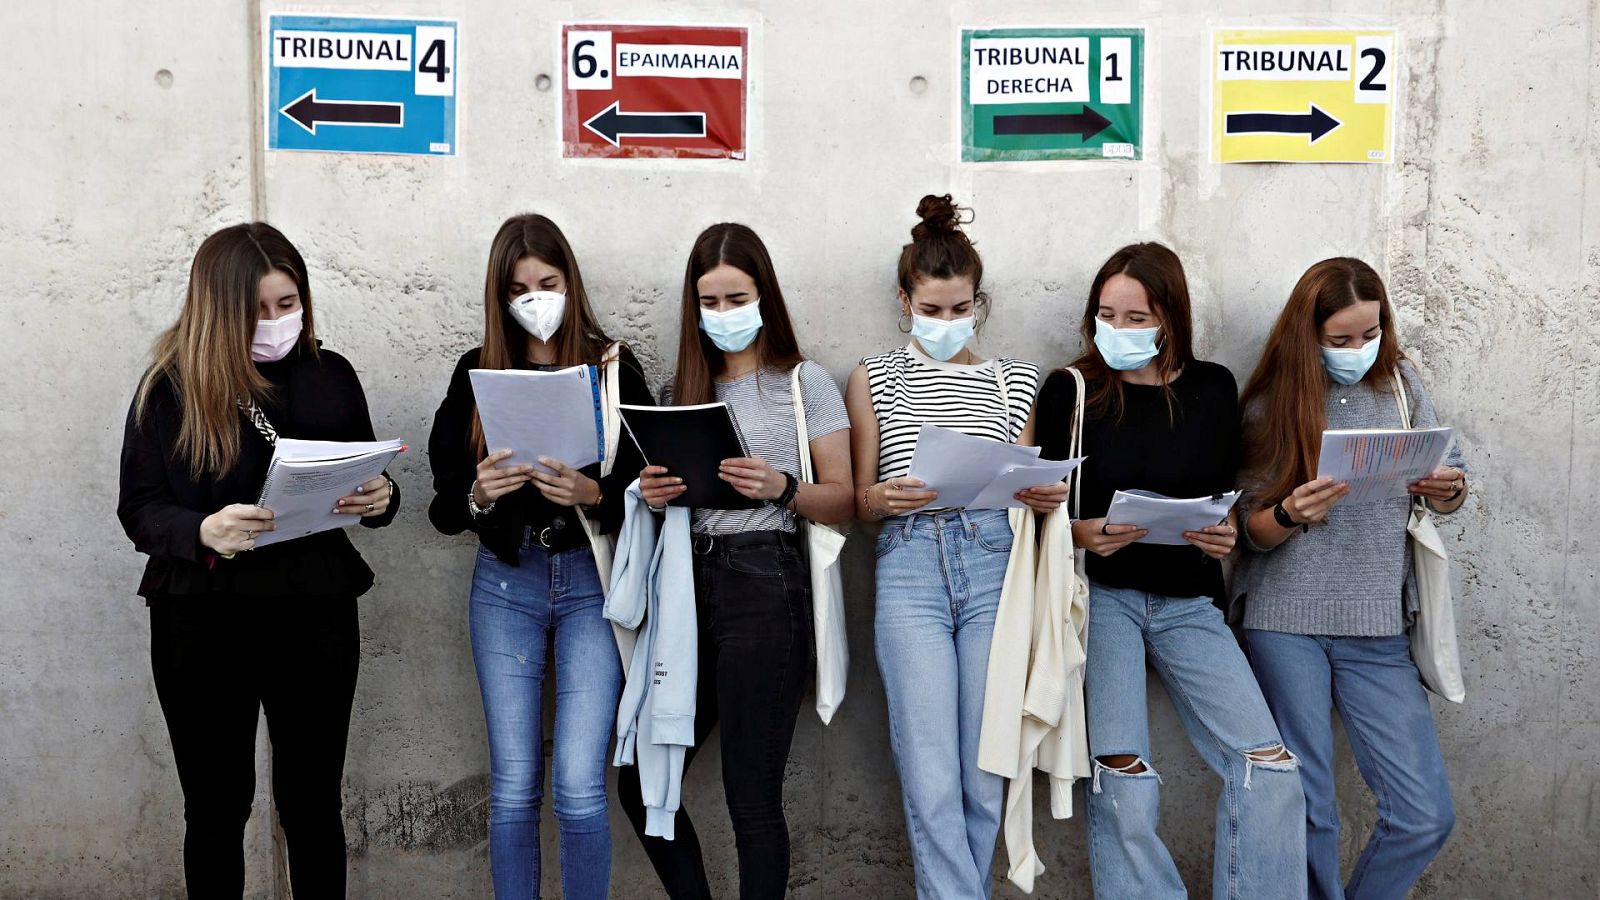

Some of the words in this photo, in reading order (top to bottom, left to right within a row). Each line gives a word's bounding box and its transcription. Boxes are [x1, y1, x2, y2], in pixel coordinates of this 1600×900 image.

[276, 37, 408, 61] TRIBUNAL
[418, 39, 450, 83] 4
[572, 39, 609, 79] 6.
[619, 52, 742, 70] EPAIMAHAIA
[974, 47, 1085, 66] TRIBUNAL
[1105, 52, 1123, 82] 1
[1220, 49, 1348, 72] TRIBUNAL
[1359, 47, 1387, 91] 2
[987, 77, 1073, 95] DERECHA
